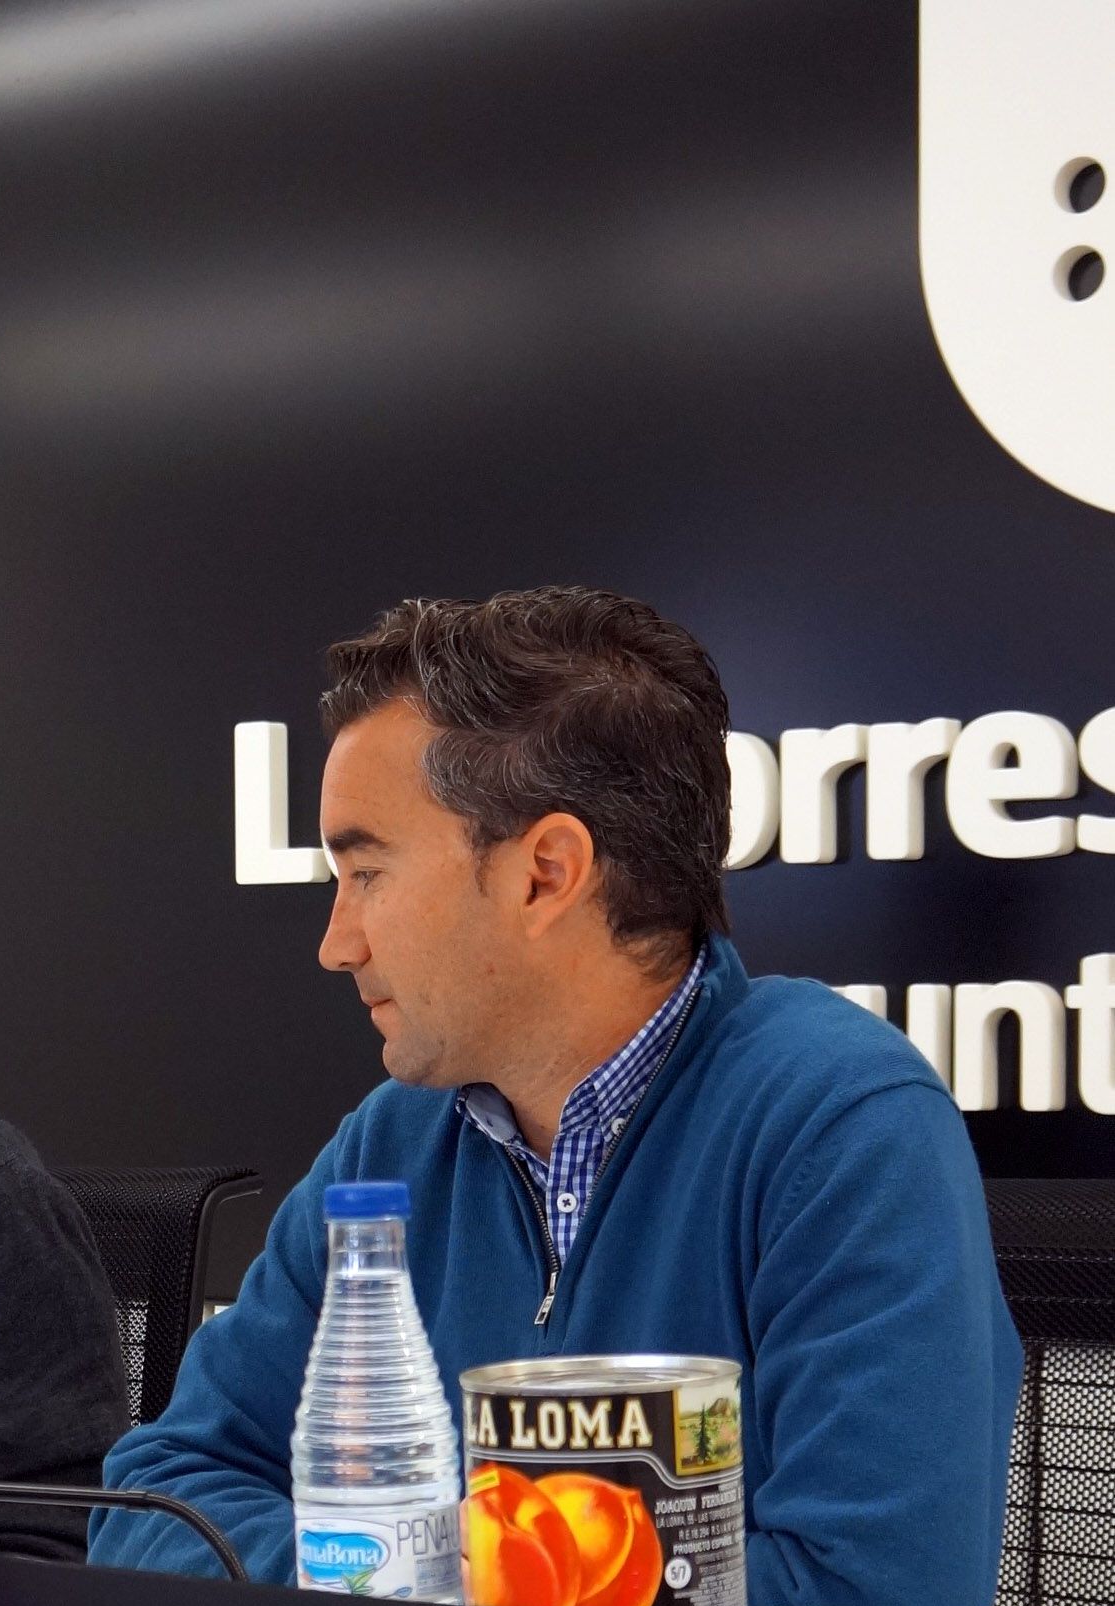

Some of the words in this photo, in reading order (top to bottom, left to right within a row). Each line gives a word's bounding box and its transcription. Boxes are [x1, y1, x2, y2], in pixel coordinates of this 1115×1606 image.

[465, 1394, 498, 1448] LA
[509, 1396, 654, 1449] LOMA
[655, 1497, 697, 1515] JOAQUIN
